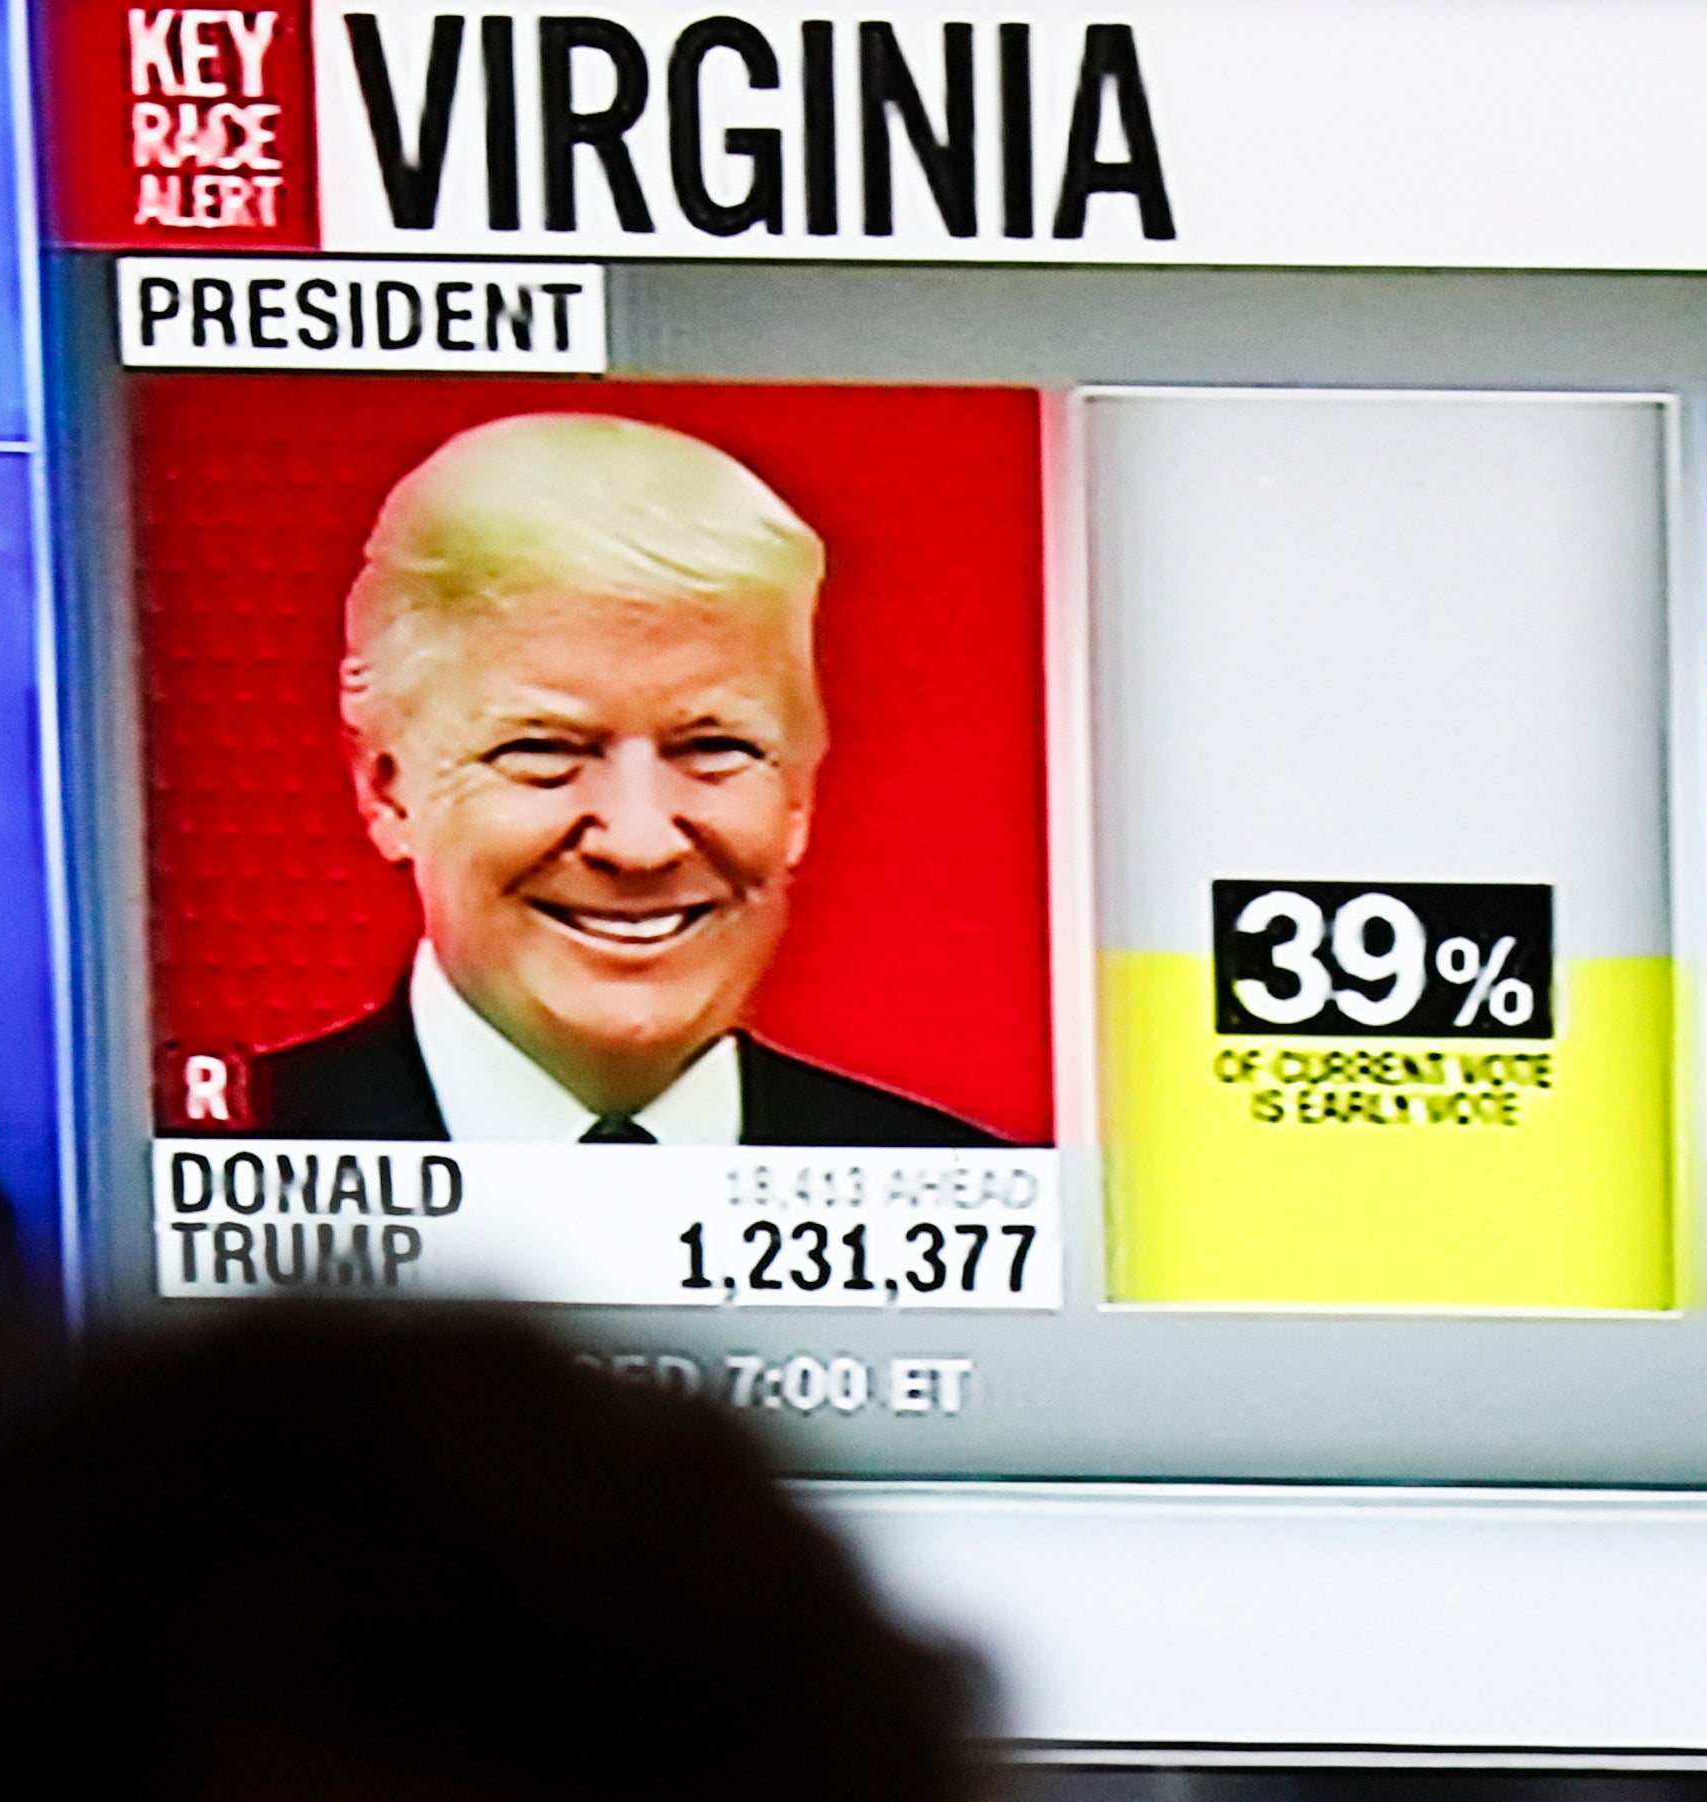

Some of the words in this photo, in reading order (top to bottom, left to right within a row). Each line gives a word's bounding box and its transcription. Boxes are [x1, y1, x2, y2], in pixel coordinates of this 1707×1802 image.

[127, 7, 279, 98] KEY
[130, 101, 282, 171] RACE
[343, 12, 1177, 241] VIRGINIA
[133, 173, 284, 229] ALERT
[139, 276, 583, 352] PRESIDENT
[1233, 889, 1534, 1027] 39%
[184, 1054, 230, 1121] R
[171, 1150, 463, 1218] DONALD
[170, 1221, 423, 1288] TRUMP
[679, 1219, 1037, 1300] 1,231,377
[725, 1355, 870, 1412] 7:00
[891, 1357, 975, 1412] ET
